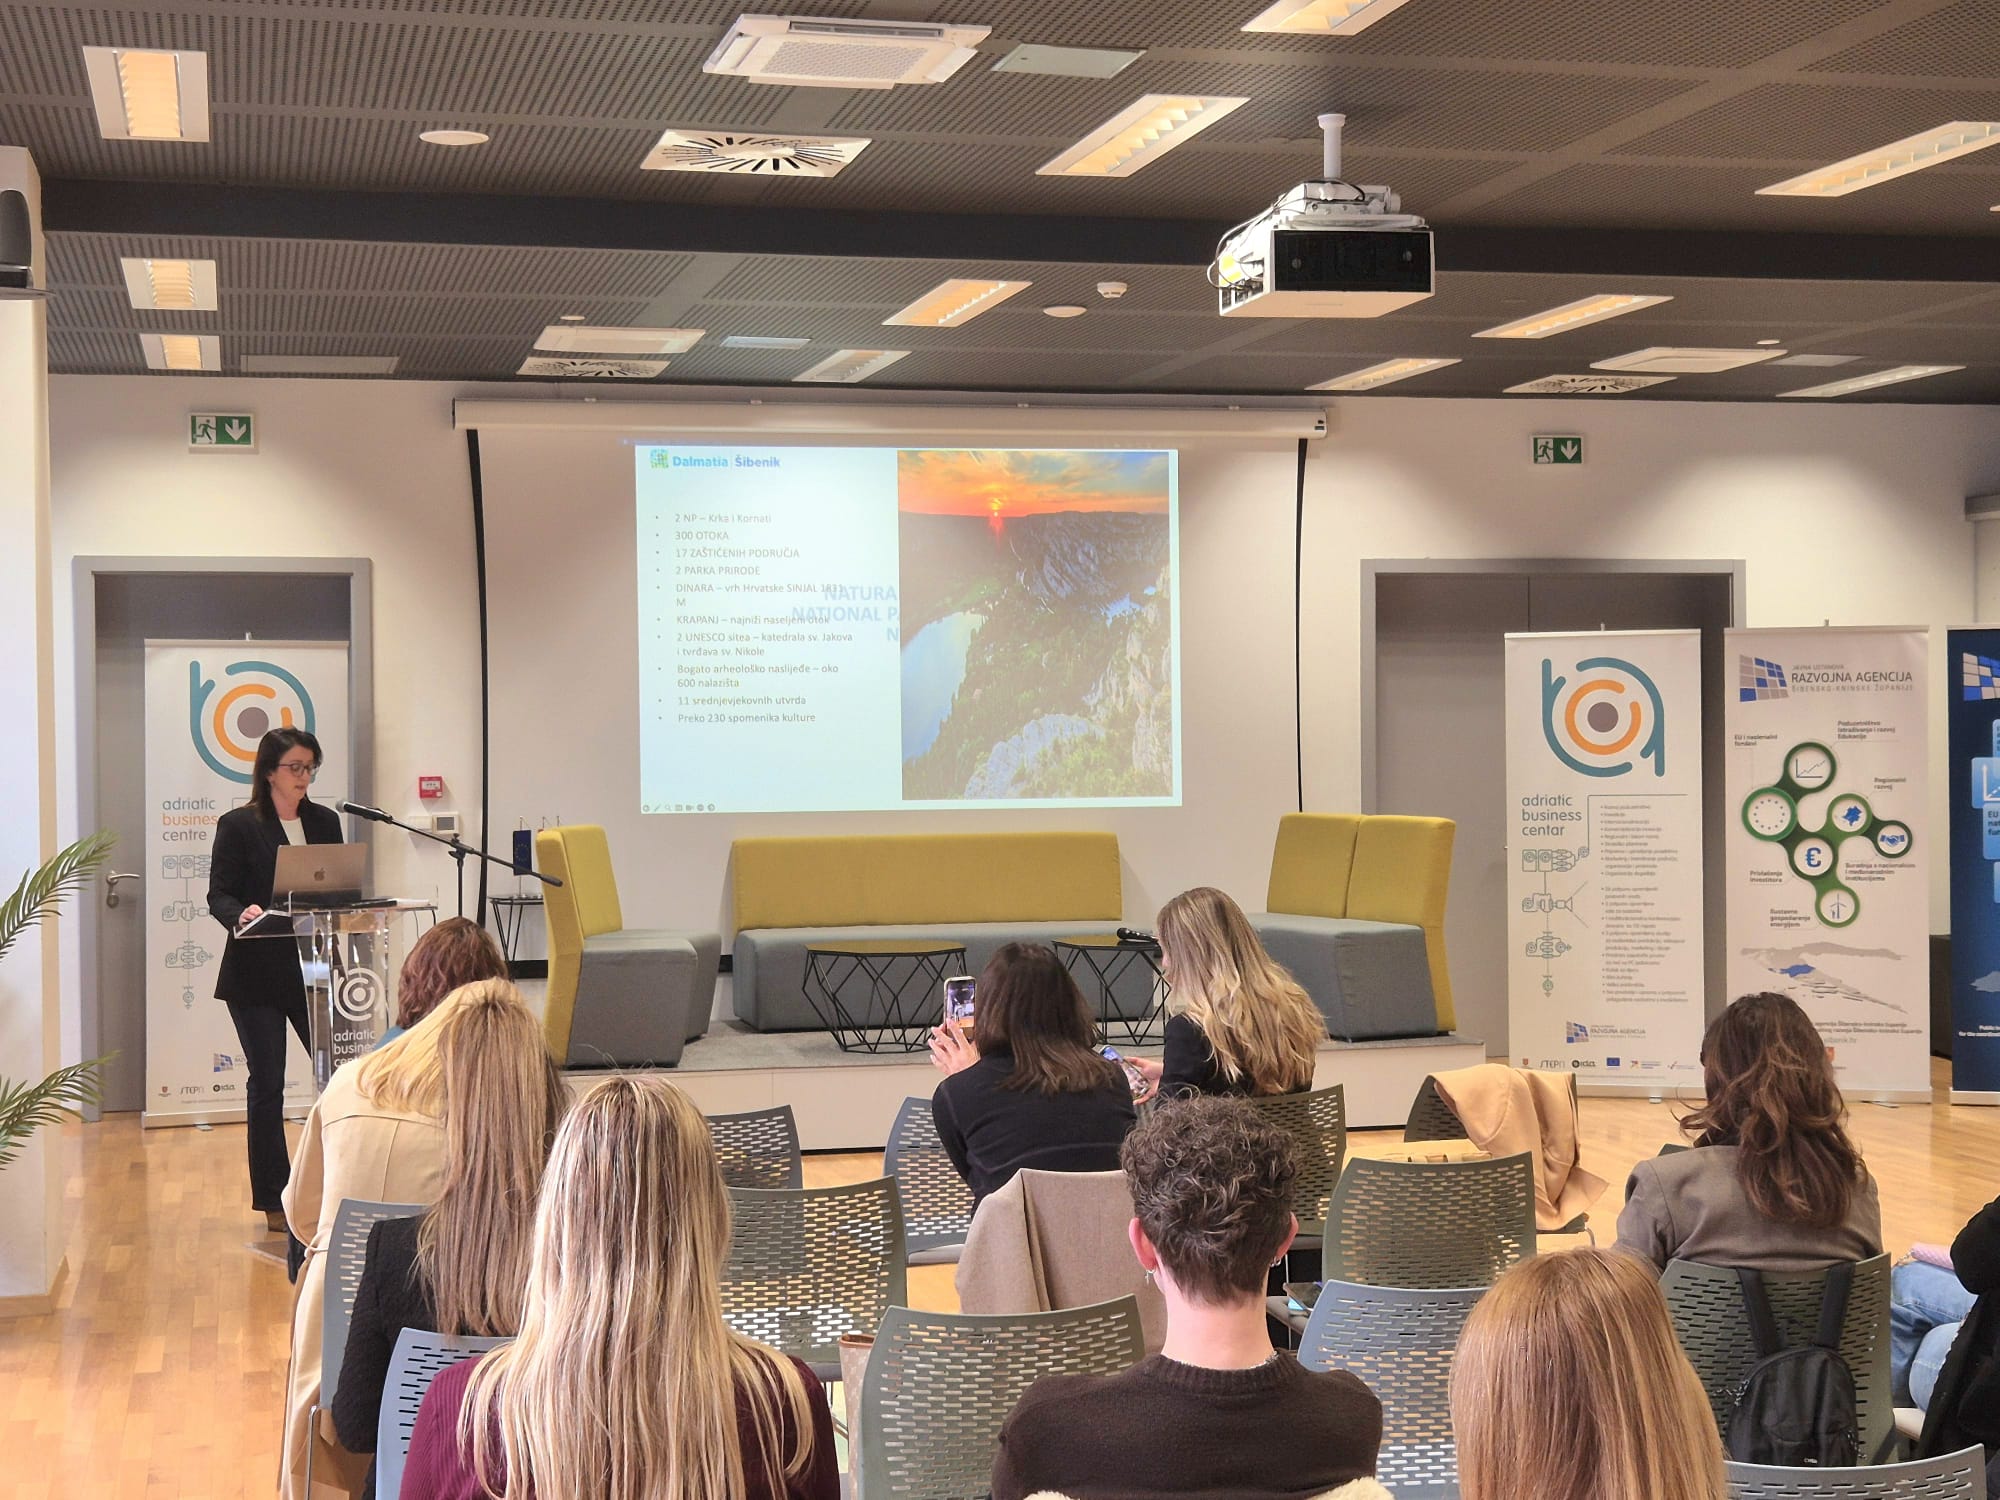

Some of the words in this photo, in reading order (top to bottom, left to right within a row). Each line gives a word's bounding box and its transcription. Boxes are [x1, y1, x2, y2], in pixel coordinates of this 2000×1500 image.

[672, 456, 729, 468] Dalmatia
[735, 454, 780, 468] Šibenik
[675, 513, 681, 523] 2
[683, 513, 697, 523] NP
[708, 513, 729, 523] Krka
[737, 513, 772, 523] Kornati
[675, 531, 693, 541] 300
[695, 531, 729, 541] OTOKA
[676, 549, 688, 559] 17
[690, 547, 746, 558] ZAŠTIĆENIH
[748, 546, 801, 558] PODRUČJA
[675, 566, 682, 576] 2
[684, 566, 716, 575] PARKA
[718, 566, 761, 575] PRIRODE
[676, 584, 715, 593] DINARA
[724, 583, 741, 593] vrh
[743, 584, 784, 593] Hrvatske
[787, 584, 818, 593] SINJAL
[676, 598, 687, 607] M
[676, 615, 720, 625] KRAPANJ
[730, 615, 761, 626] najniži
[791, 607, 882, 622] NATIONAL
[677, 632, 683, 642] 2
[685, 632, 726, 642] UNESCO
[728, 632, 750, 642] sitea
[761, 632, 805, 642] katedrala
[822, 632, 853, 642] Jakova
[682, 646, 718, 656] tvrđava
[735, 646, 765, 656] Nikole
[677, 664, 711, 675] Bogato
[713, 663, 766, 674] arheološko
[821, 664, 839, 674] oko
[677, 678, 695, 688] 600
[697, 677, 739, 688] nalazišta
[1791, 671, 1852, 684] RAZVOJNA
[1855, 671, 1913, 683] AGENCIJA
[678, 696, 689, 706] 11
[692, 695, 772, 707] srednjevjekovnih
[775, 694, 807, 705] utvrda
[678, 713, 705, 723] Preko
[707, 713, 725, 723] 230
[728, 713, 780, 724] spomenika
[782, 712, 816, 723] kulture
[162, 797, 217, 810] adriatic
[1521, 794, 1573, 807] adriatic
[162, 812, 218, 826] busines
[1521, 809, 1582, 821] business
[162, 829, 207, 842] centre
[1521, 824, 1565, 836] centar
[333, 1028, 376, 1042] adriatic
[333, 1042, 376, 1055] busine
